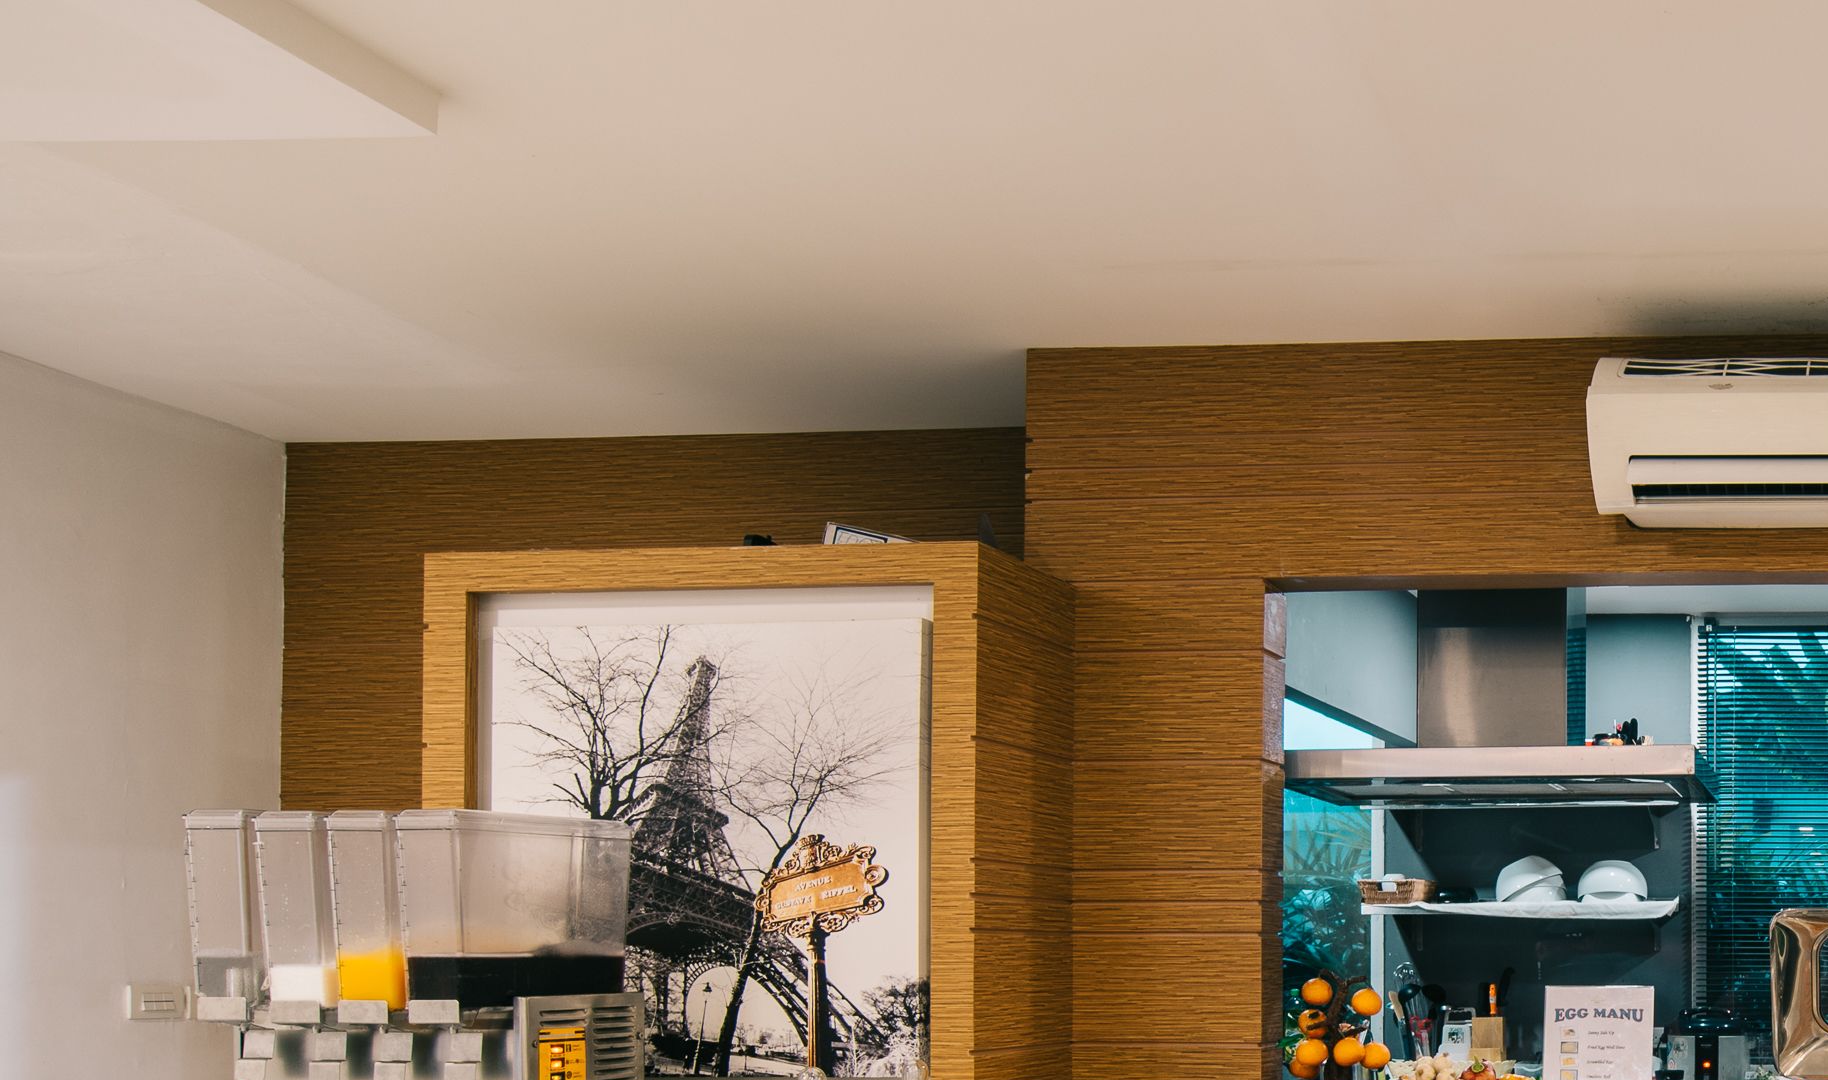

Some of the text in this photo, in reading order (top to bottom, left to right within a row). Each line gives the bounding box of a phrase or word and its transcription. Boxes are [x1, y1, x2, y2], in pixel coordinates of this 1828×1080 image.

[795, 875, 832, 892] AVENUE
[1554, 1008, 1644, 1023] EGG MANU
